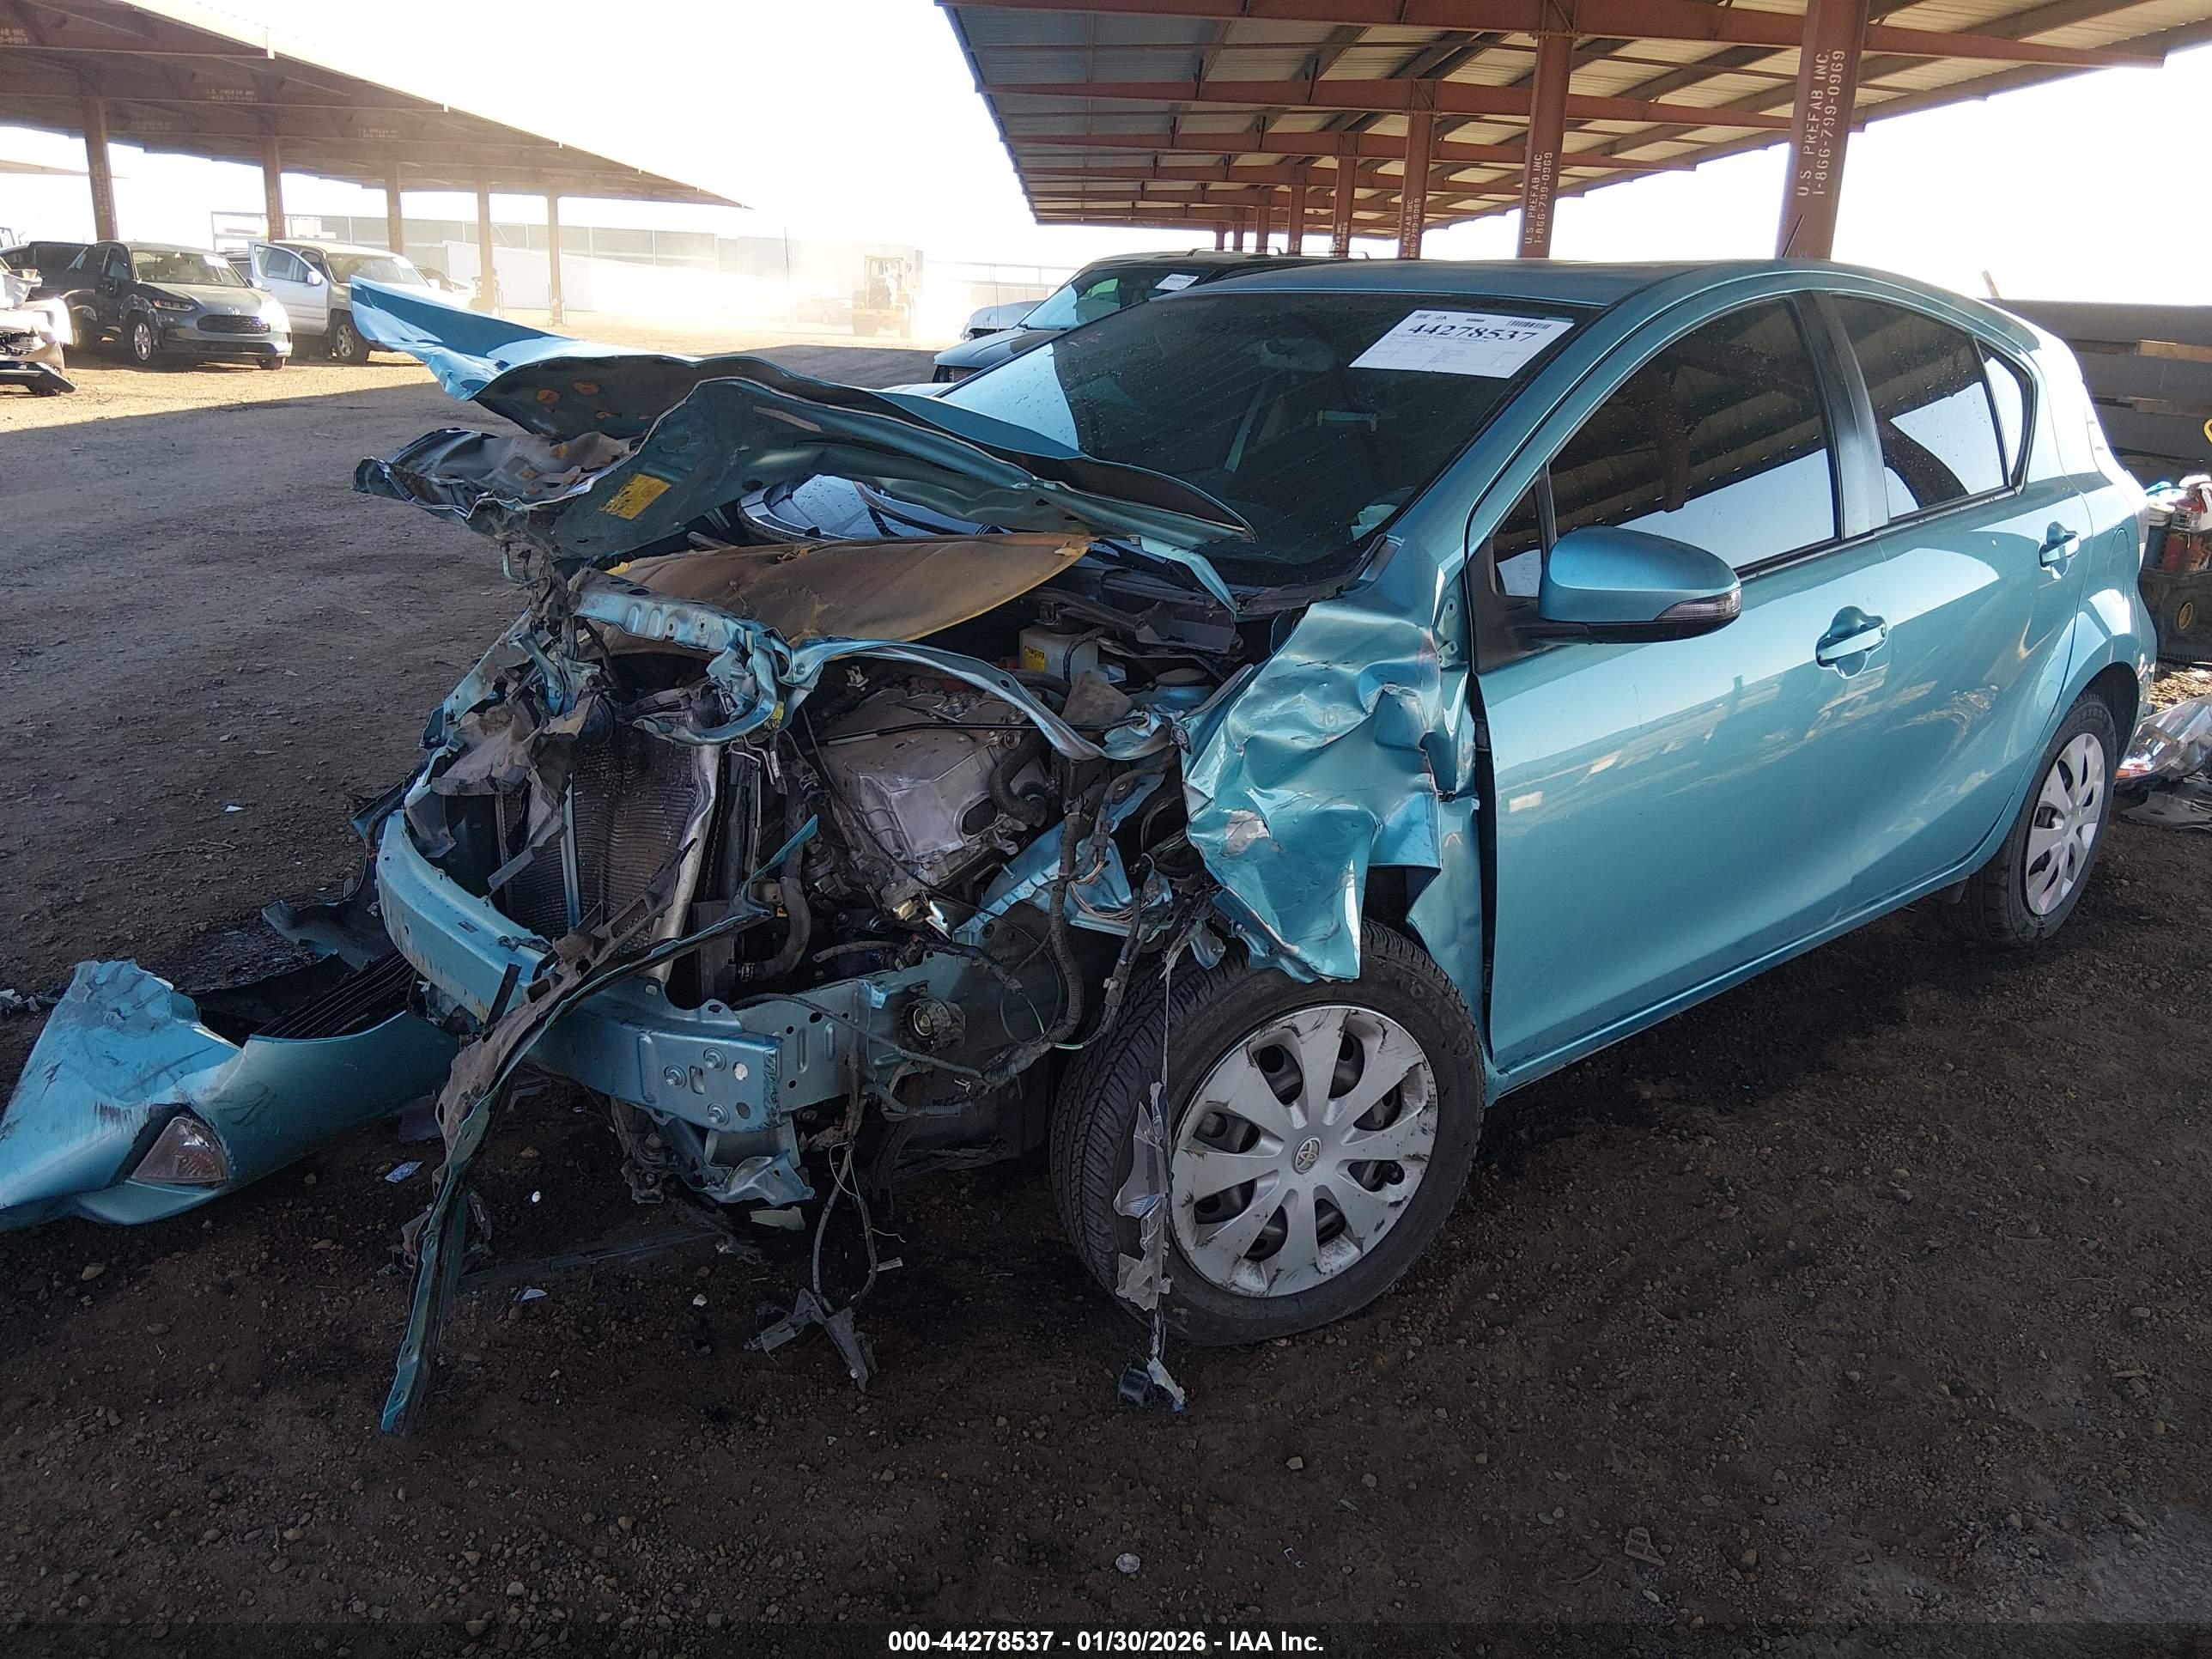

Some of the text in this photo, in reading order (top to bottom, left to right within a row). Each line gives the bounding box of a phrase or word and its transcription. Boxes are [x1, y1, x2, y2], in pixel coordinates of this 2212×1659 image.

[1802, 89, 1824, 155] PREFAB
[1814, 49, 1830, 81] INC.
[1813, 50, 1845, 195] 1-866-799-0969
[1528, 176, 1540, 218] PREFAB
[1407, 323, 1539, 343] 44278537
